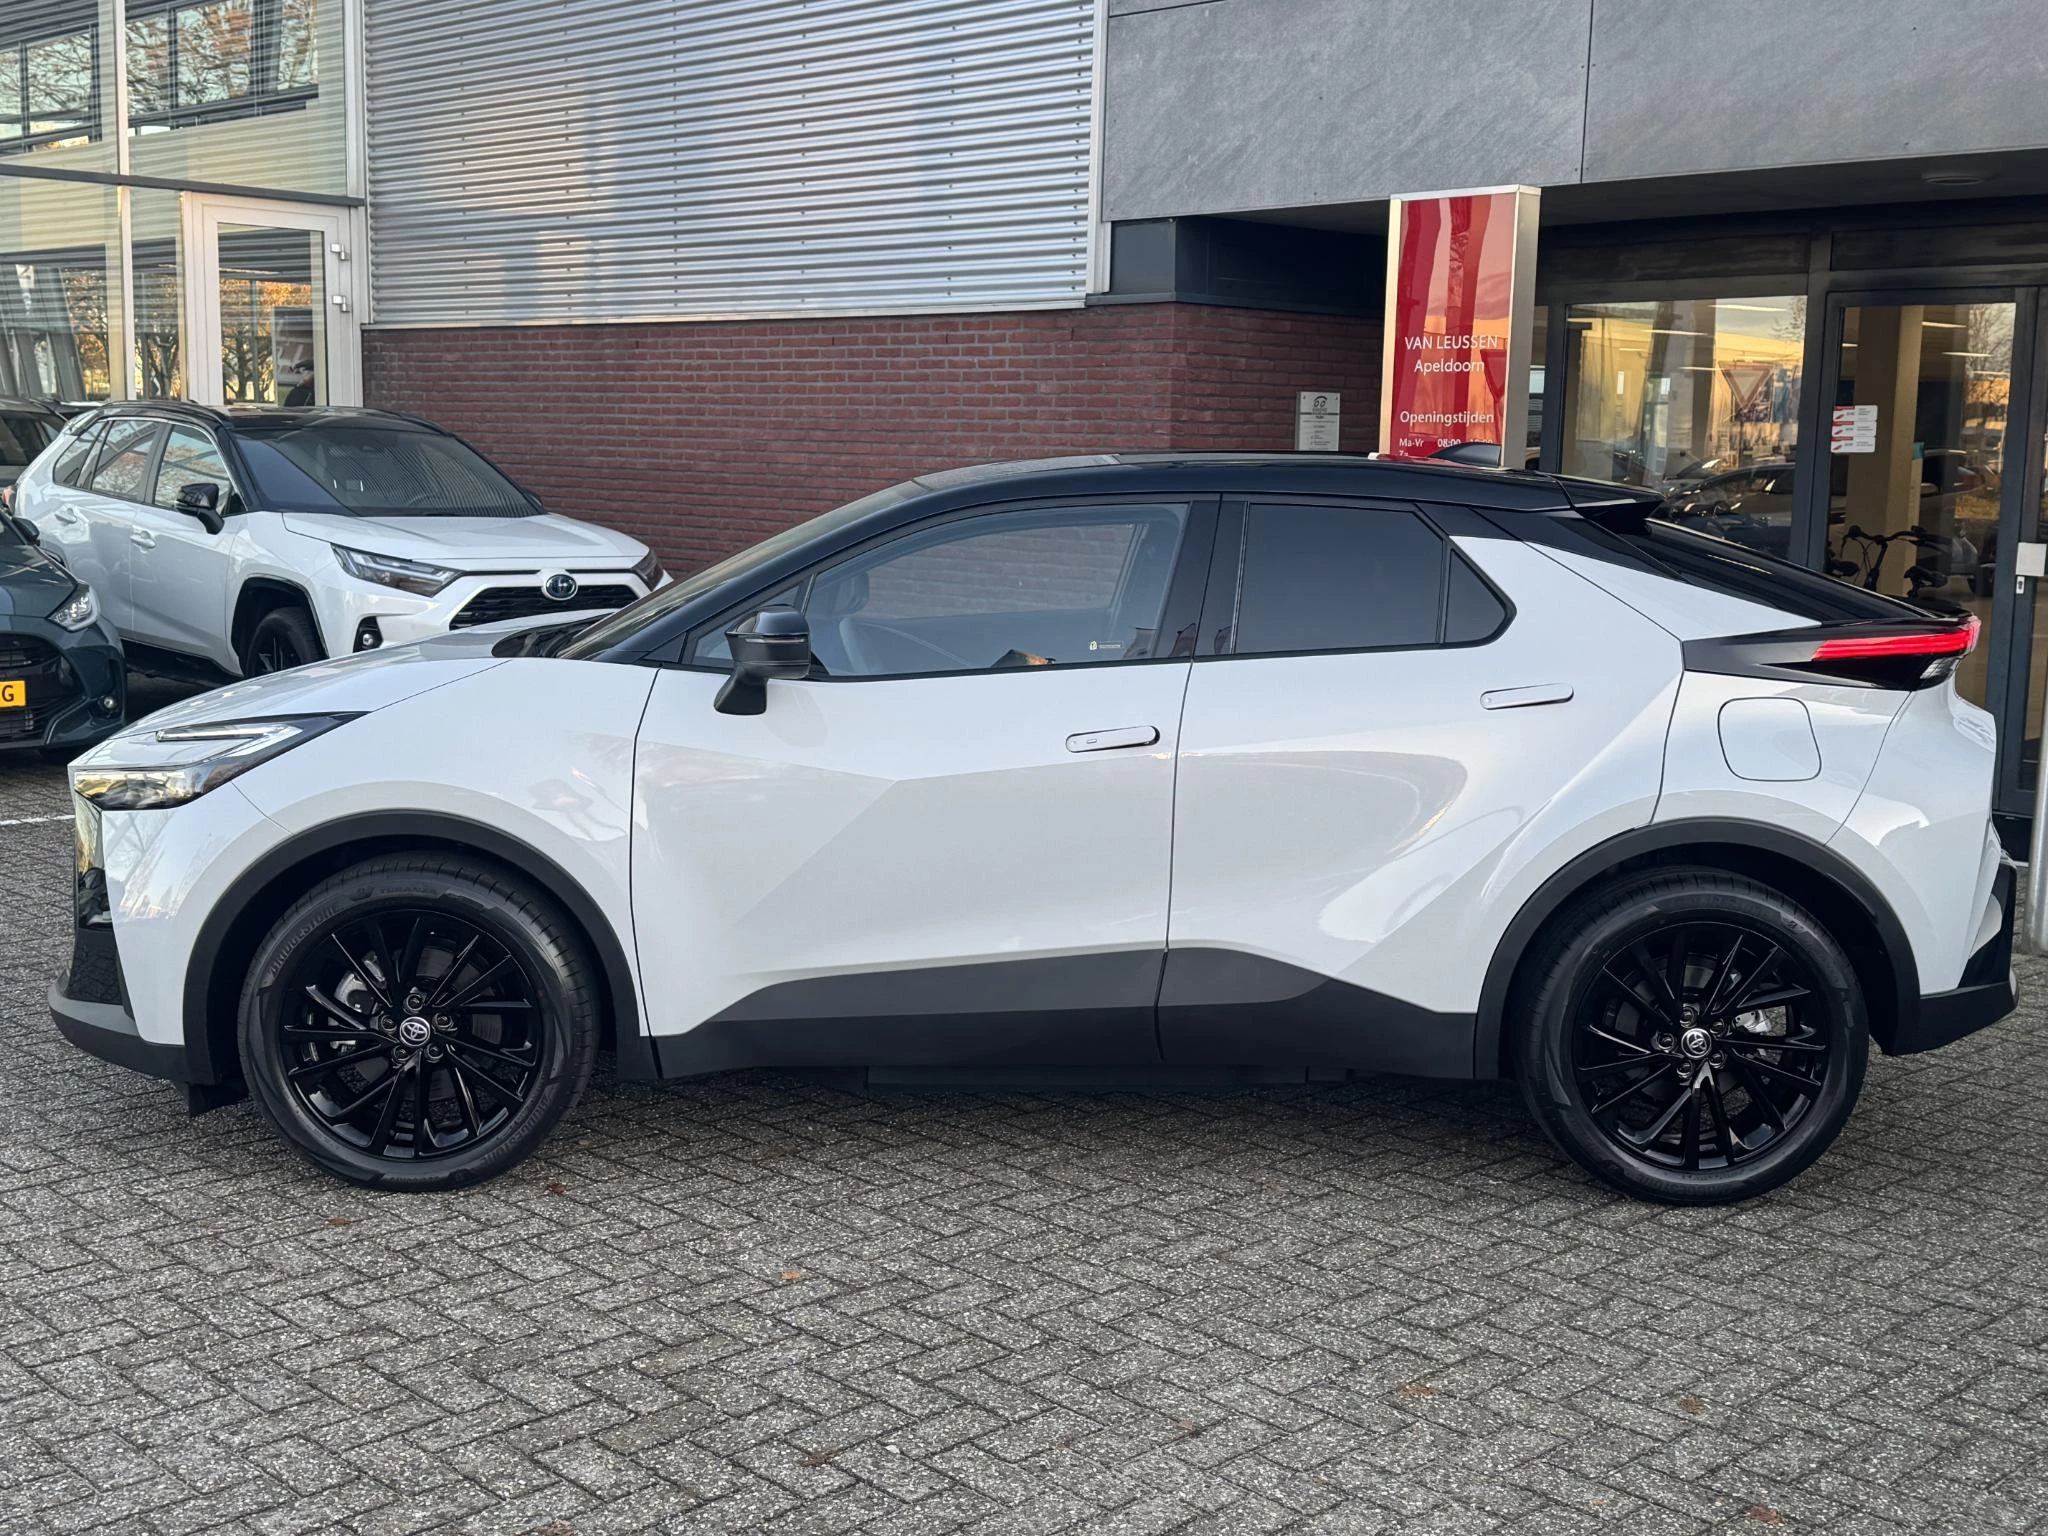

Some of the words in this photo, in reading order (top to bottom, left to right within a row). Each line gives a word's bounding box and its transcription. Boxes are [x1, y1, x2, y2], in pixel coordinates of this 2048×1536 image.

[1404, 336, 1433, 350] VAN
[1436, 335, 1498, 349] LEUSSEN
[1413, 358, 1485, 375] Apeldoorn
[1399, 410, 1494, 427] Openingstijden
[1399, 437, 1424, 447] Ma-Vr
